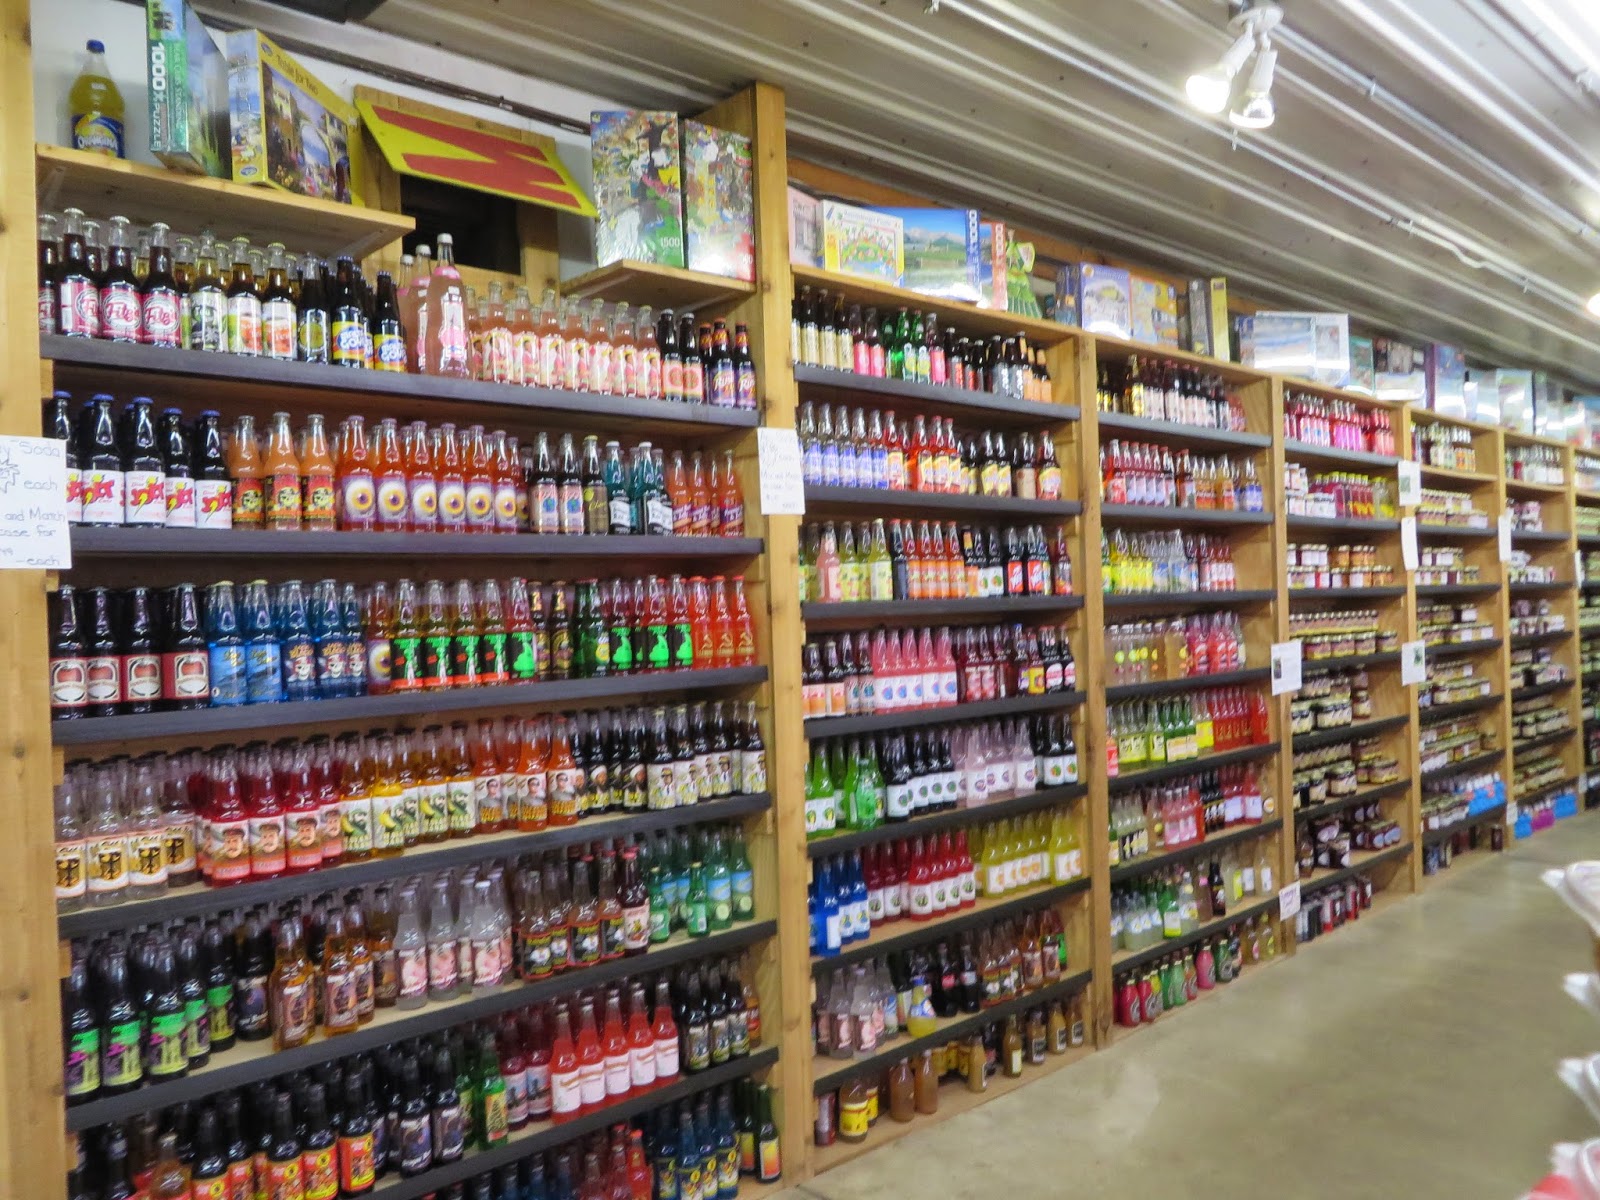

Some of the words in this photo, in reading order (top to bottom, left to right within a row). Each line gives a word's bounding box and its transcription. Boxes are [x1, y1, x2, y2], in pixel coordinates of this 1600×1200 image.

[151, 42, 166, 91] 1000
[153, 102, 161, 148] PUZZLE
[19, 441, 61, 458] Soda
[24, 477, 58, 491] each
[26, 556, 60, 566] each
